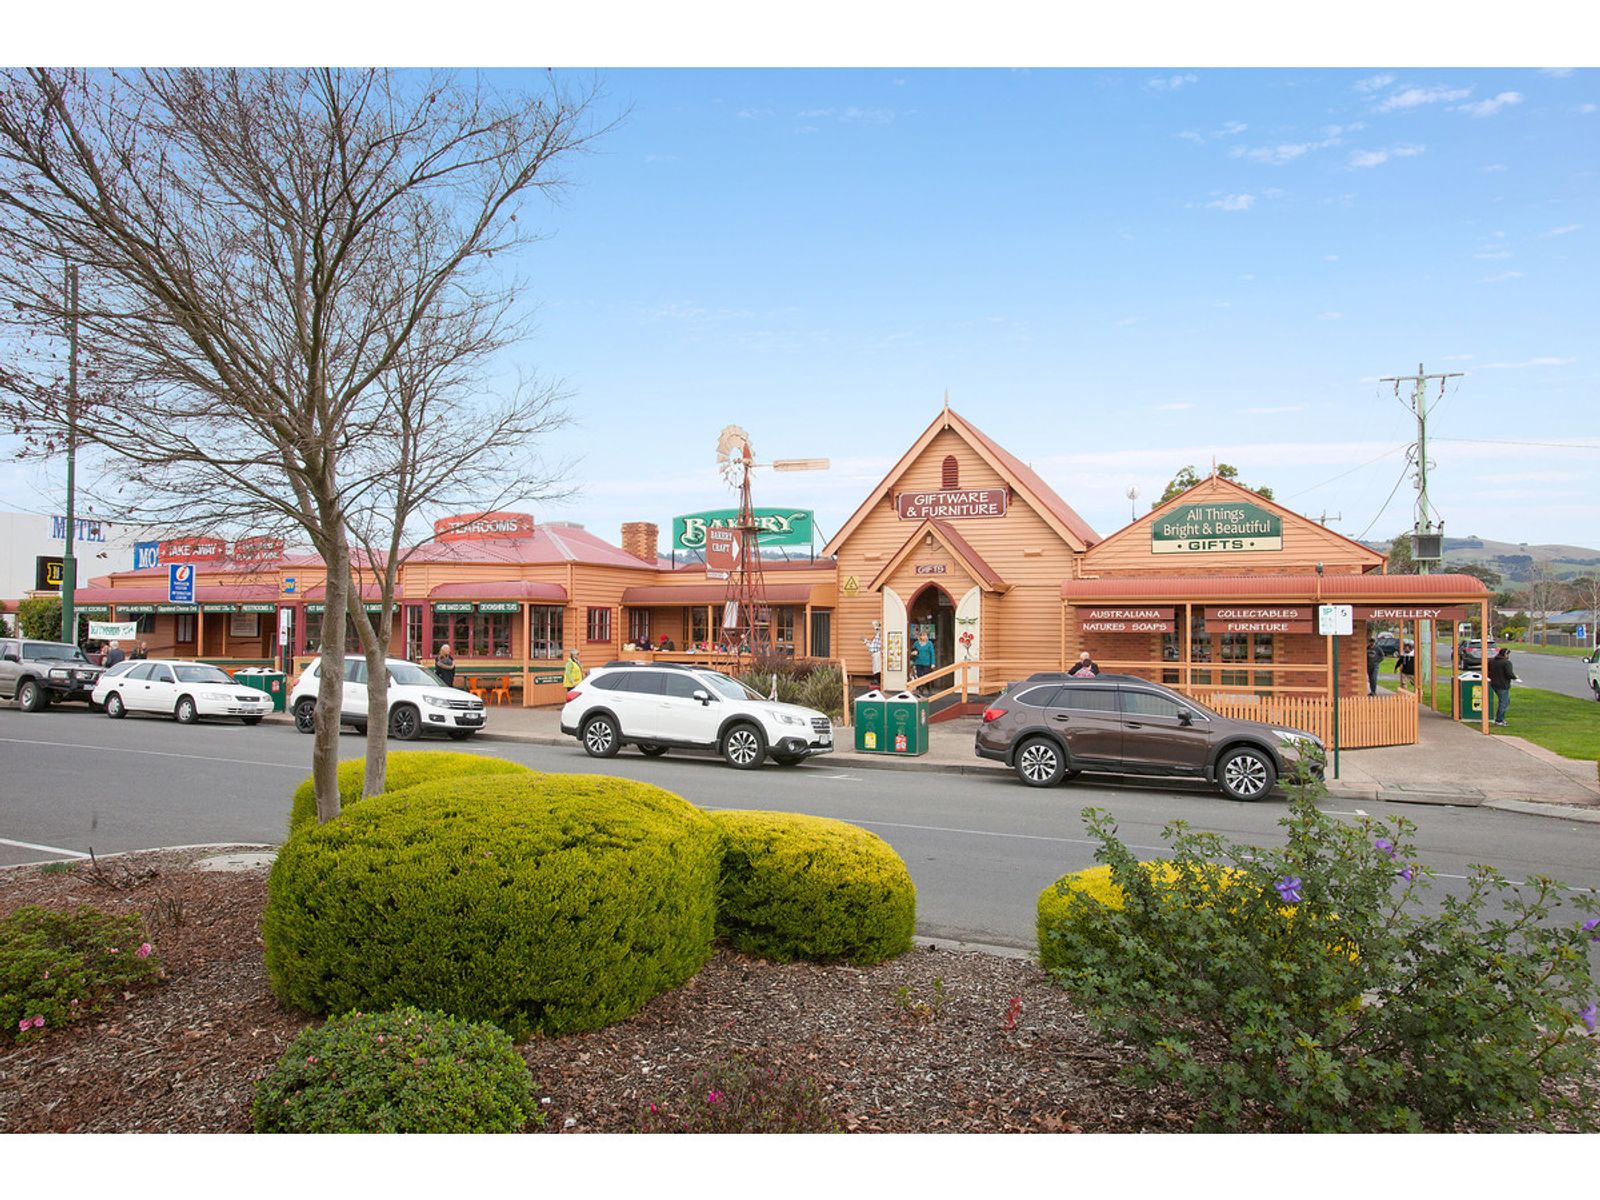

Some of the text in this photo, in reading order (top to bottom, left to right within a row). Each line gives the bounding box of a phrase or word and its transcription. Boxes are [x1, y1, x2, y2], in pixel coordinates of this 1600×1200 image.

[914, 492, 989, 505] GIFTWARE
[906, 504, 998, 517] & FURNITURE
[1187, 508, 1245, 523] All Things
[52, 515, 106, 542] MTEL
[448, 519, 519, 534] TEAROOMS
[1163, 520, 1271, 539] Bright & Beautiful
[1188, 540, 1243, 551] GIFTS
[1089, 610, 1160, 619] AUSTRALIANA
[1217, 609, 1298, 618] COLLECTABLES
[1369, 609, 1442, 618] JEWELLERY
[1083, 622, 1167, 631] NATURES SOAPS
[1227, 623, 1289, 631] FURNITURE
